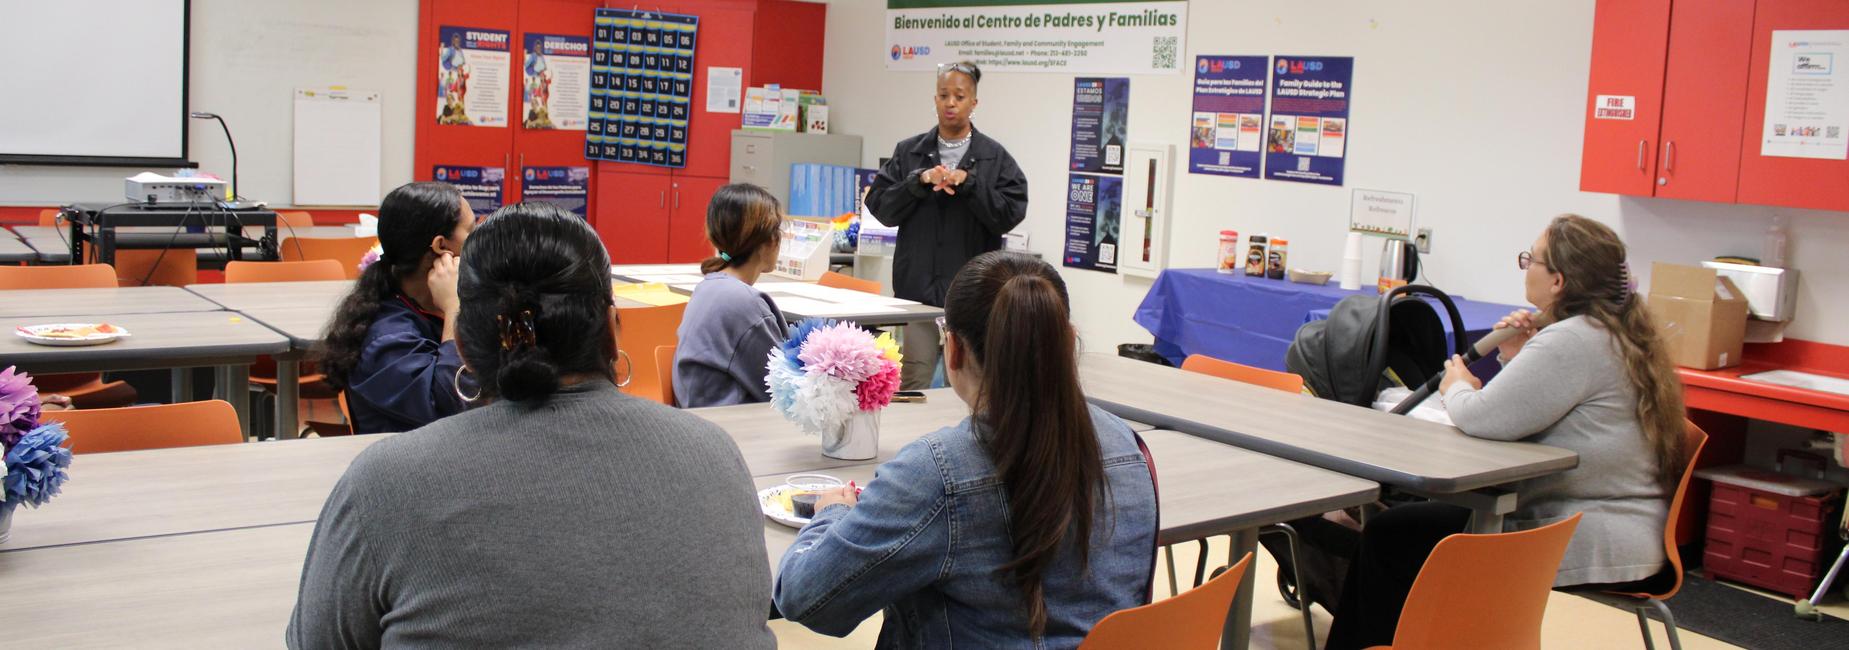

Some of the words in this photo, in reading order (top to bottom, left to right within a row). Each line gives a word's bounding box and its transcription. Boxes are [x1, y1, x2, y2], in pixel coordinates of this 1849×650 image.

[894, 14, 960, 29] Bienvenido
[963, 14, 974, 28] al
[977, 14, 1022, 28] Centro
[1024, 13, 1040, 27] de
[1044, 12, 1093, 27] Padres
[1097, 15, 1105, 32] y
[1109, 9, 1177, 26] Familias
[466, 31, 507, 42] STUDENT
[598, 29, 607, 38] 01
[615, 31, 624, 39] 02
[632, 32, 641, 41] 03
[648, 33, 656, 42] 04
[664, 35, 673, 44] 05
[681, 36, 690, 45] 06
[544, 41, 587, 51] DERECHOS
[903, 46, 930, 55] LAUSD
[596, 52, 605, 62] 07
[613, 54, 622, 63] 08
[630, 56, 639, 65] 09
[646, 57, 654, 65] 10
[662, 58, 669, 67] 11
[679, 60, 687, 69] 12
[1211, 60, 1240, 69] LAUSD
[1291, 60, 1323, 70] LAUSD
[595, 76, 603, 84] 13
[612, 77, 620, 86] 14
[628, 79, 637, 88] 15
[644, 80, 652, 89] 16
[660, 81, 668, 90] 17
[676, 83, 684, 93] 18
[1280, 79, 1303, 89] Family
[1303, 80, 1323, 88] Guide
[1277, 88, 1298, 96] LAUSD
[1299, 89, 1329, 99] Strategic
[594, 99, 602, 108] 19
[610, 100, 619, 110] 20
[626, 102, 635, 111] 21
[642, 103, 651, 112] 22
[658, 105, 667, 114] 23
[674, 106, 683, 115] 24
[1607, 98, 1624, 107] FIRE
[590, 122, 600, 131] 25
[608, 124, 617, 133] 26
[624, 125, 634, 134] 27
[640, 127, 649, 136] 28
[656, 128, 664, 137] 29
[673, 130, 682, 139] 30
[589, 145, 598, 154] 31
[605, 146, 616, 156] 32
[622, 148, 632, 157] 33
[639, 150, 648, 158] 34
[654, 152, 663, 161] 35
[672, 154, 681, 163] 36
[449, 169, 478, 177] LAUSD
[1071, 190, 1093, 202] ONE
